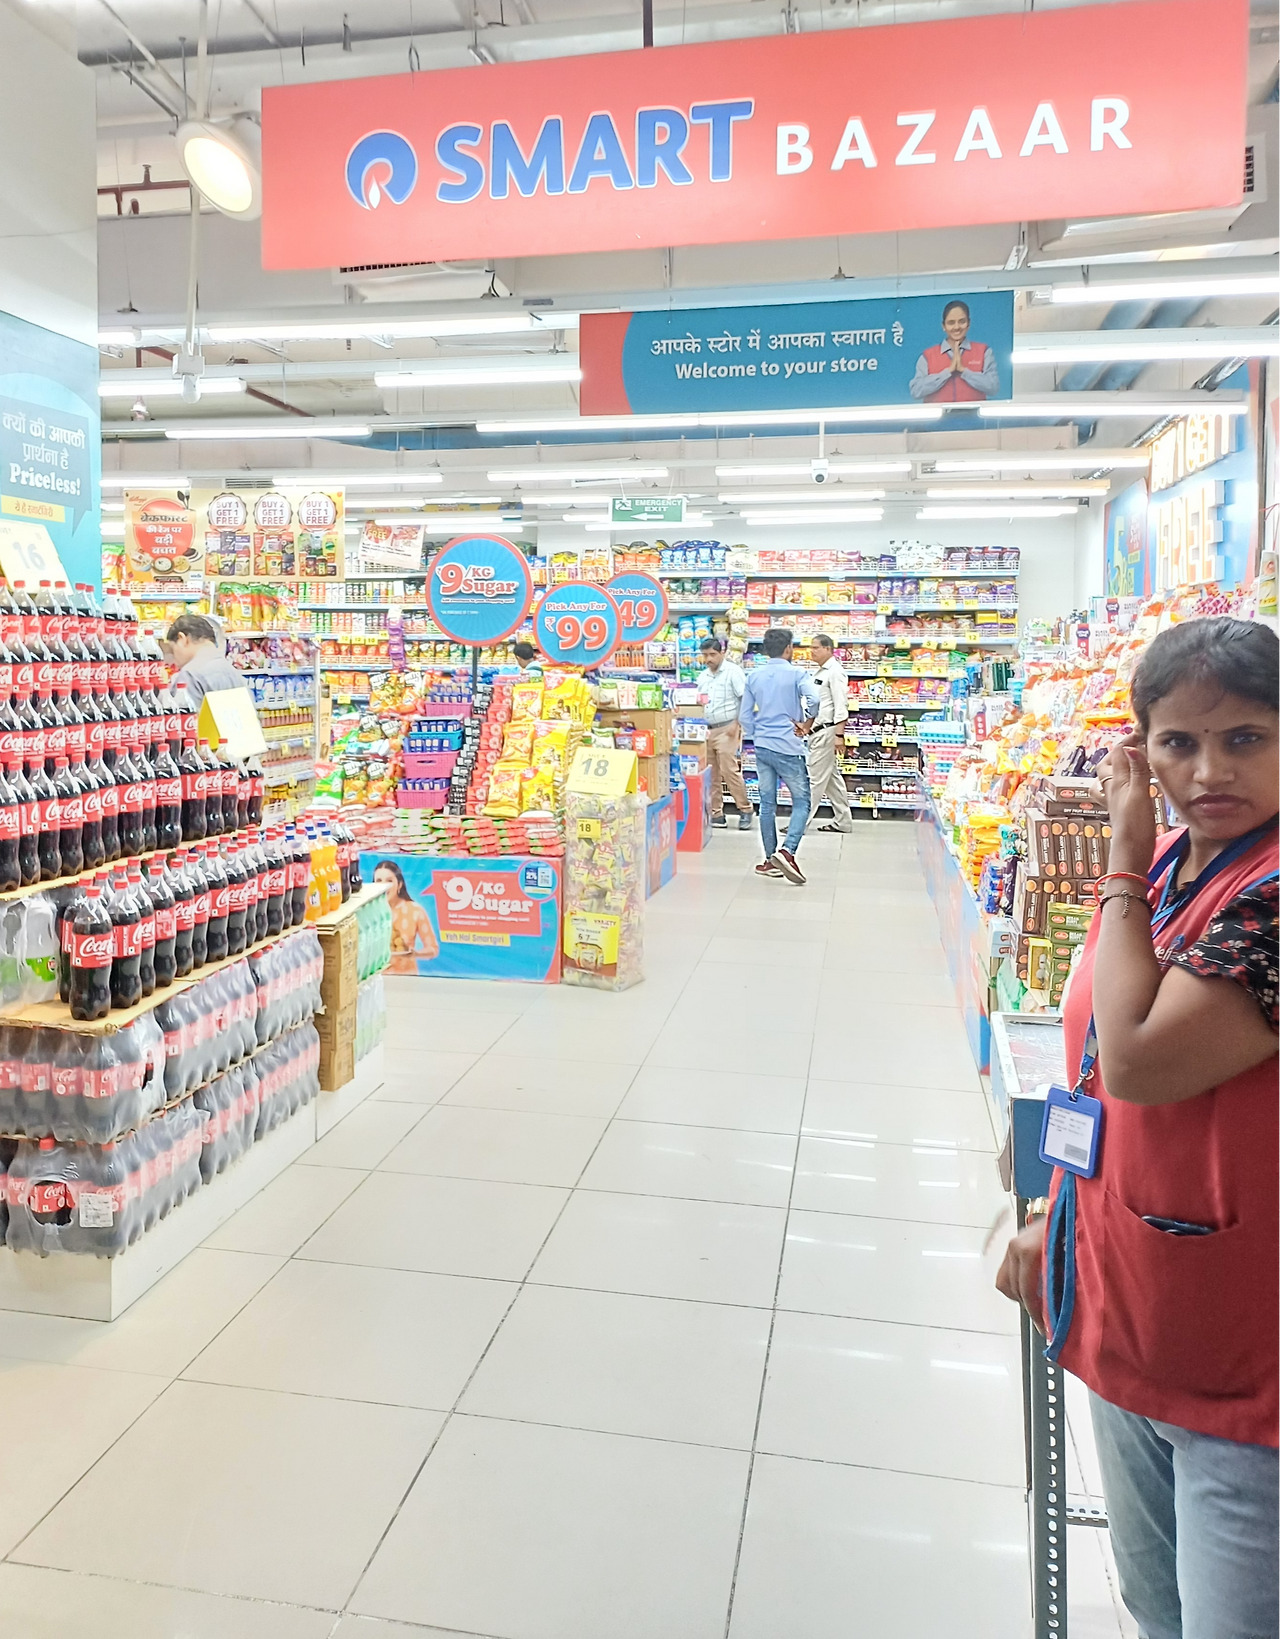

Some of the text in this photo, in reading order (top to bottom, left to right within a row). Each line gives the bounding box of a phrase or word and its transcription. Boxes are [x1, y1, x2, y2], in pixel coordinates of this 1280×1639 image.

[435, 96, 1134, 203] SMART BAZAAR
[650, 321, 904, 356] आपके स्टोर में आपका स्वागत है
[675, 357, 878, 380] Welcome to your store
[9, 462, 81, 496] Priceless!
[635, 499, 682, 507] EMERGENCY
[306, 516, 328, 524] FREE
[367, 529, 387, 539] FREE
[1155, 481, 1219, 593] FREE
[12, 541, 46, 571] 16
[462, 579, 516, 595] Sugar
[626, 589, 640, 597] Any
[546, 602, 606, 613] Pick Any For
[582, 758, 609, 777] 18
[579, 823, 591, 833] 18
[471, 894, 534, 915] Sugar
[445, 933, 458, 941] Yeh
[459, 934, 471, 942] Hai
